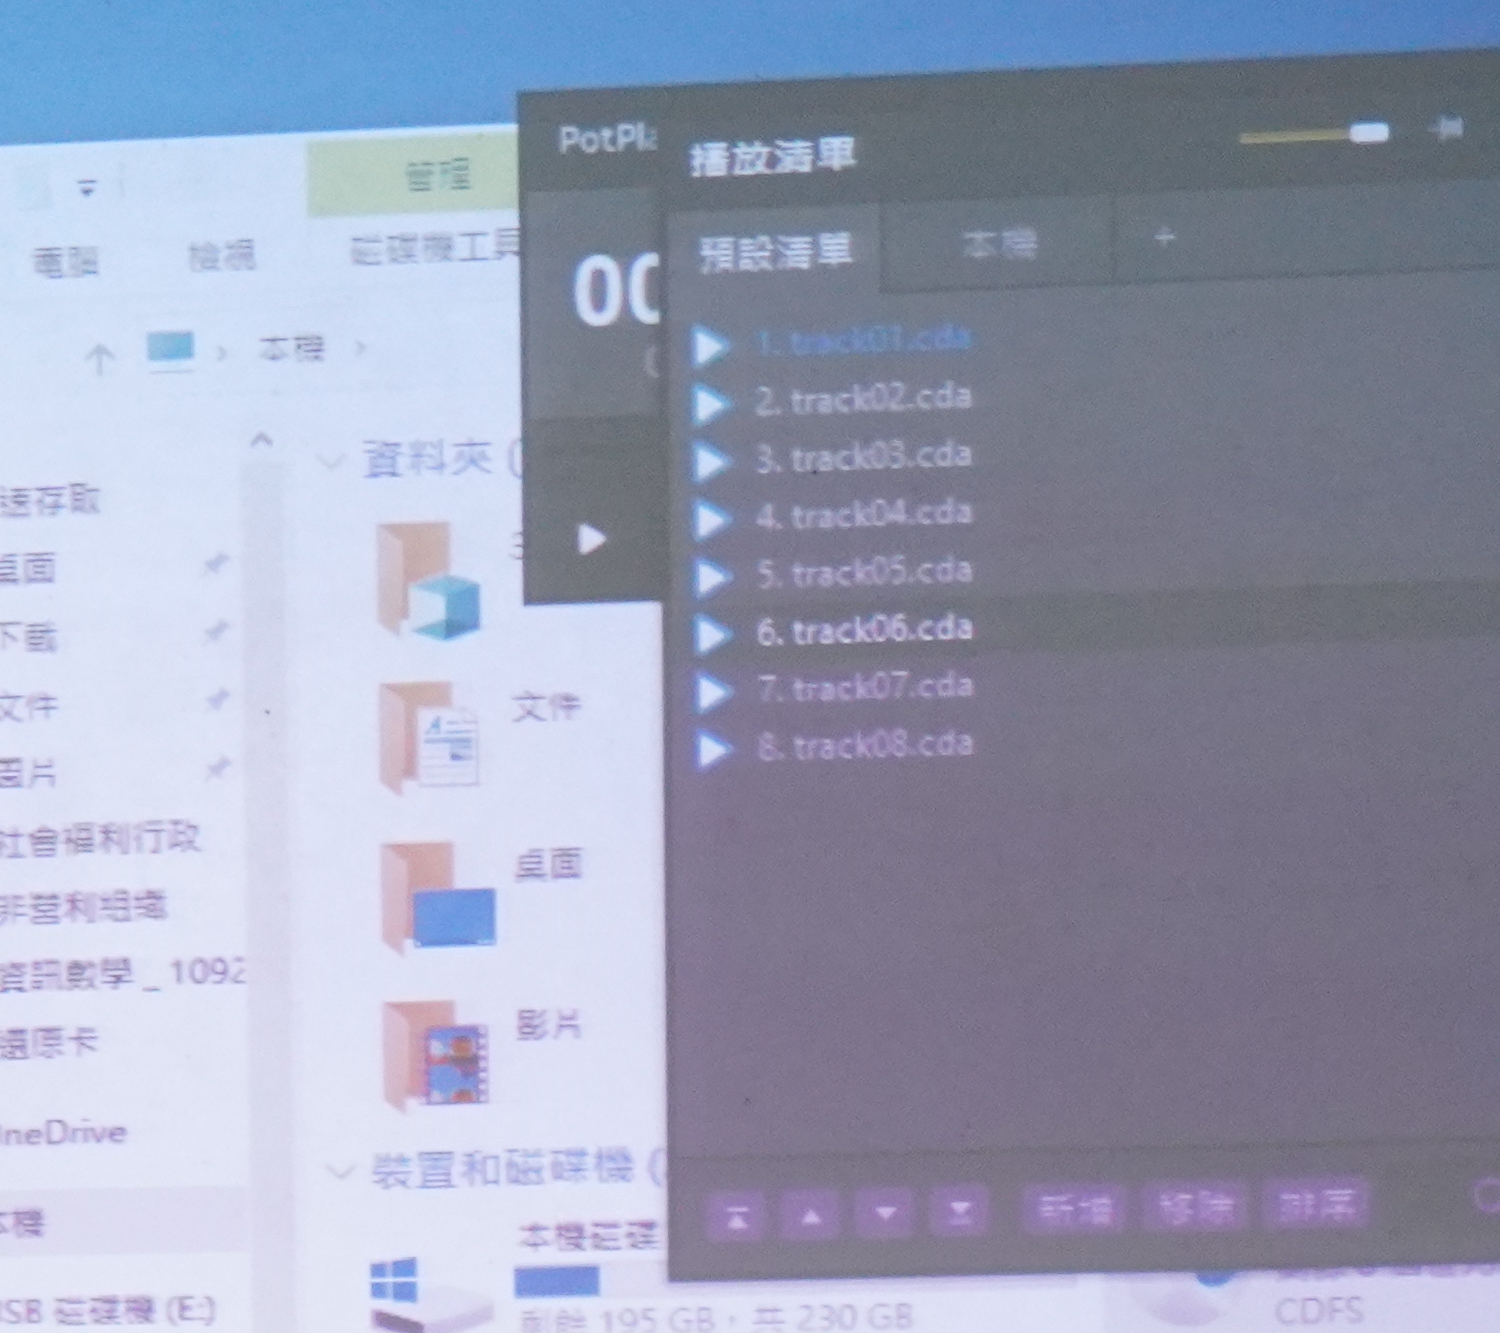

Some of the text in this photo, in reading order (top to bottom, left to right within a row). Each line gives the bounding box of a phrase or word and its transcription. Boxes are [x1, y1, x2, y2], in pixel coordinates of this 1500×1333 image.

[690, 135, 857, 177] 播放清單
[31, 245, 99, 279] 電腦
[700, 231, 853, 274] 預設清單
[755, 381, 973, 416] 2. track02.cda
[363, 439, 494, 479] 資料夾
[757, 440, 973, 473] 3. track03.cda
[757, 497, 973, 529] 4. track04.cda
[758, 555, 973, 588] 5. track05.cda
[757, 613, 973, 646] 6. track06.cda
[759, 669, 974, 703] 7. track07.cda
[512, 691, 582, 723] 文件
[794, 728, 974, 761] track08.cda
[515, 847, 584, 882] 桌面
[796, 1303, 858, 1332] 230
[868, 1302, 914, 1330] GB
[1275, 1296, 1365, 1326] CDFS
